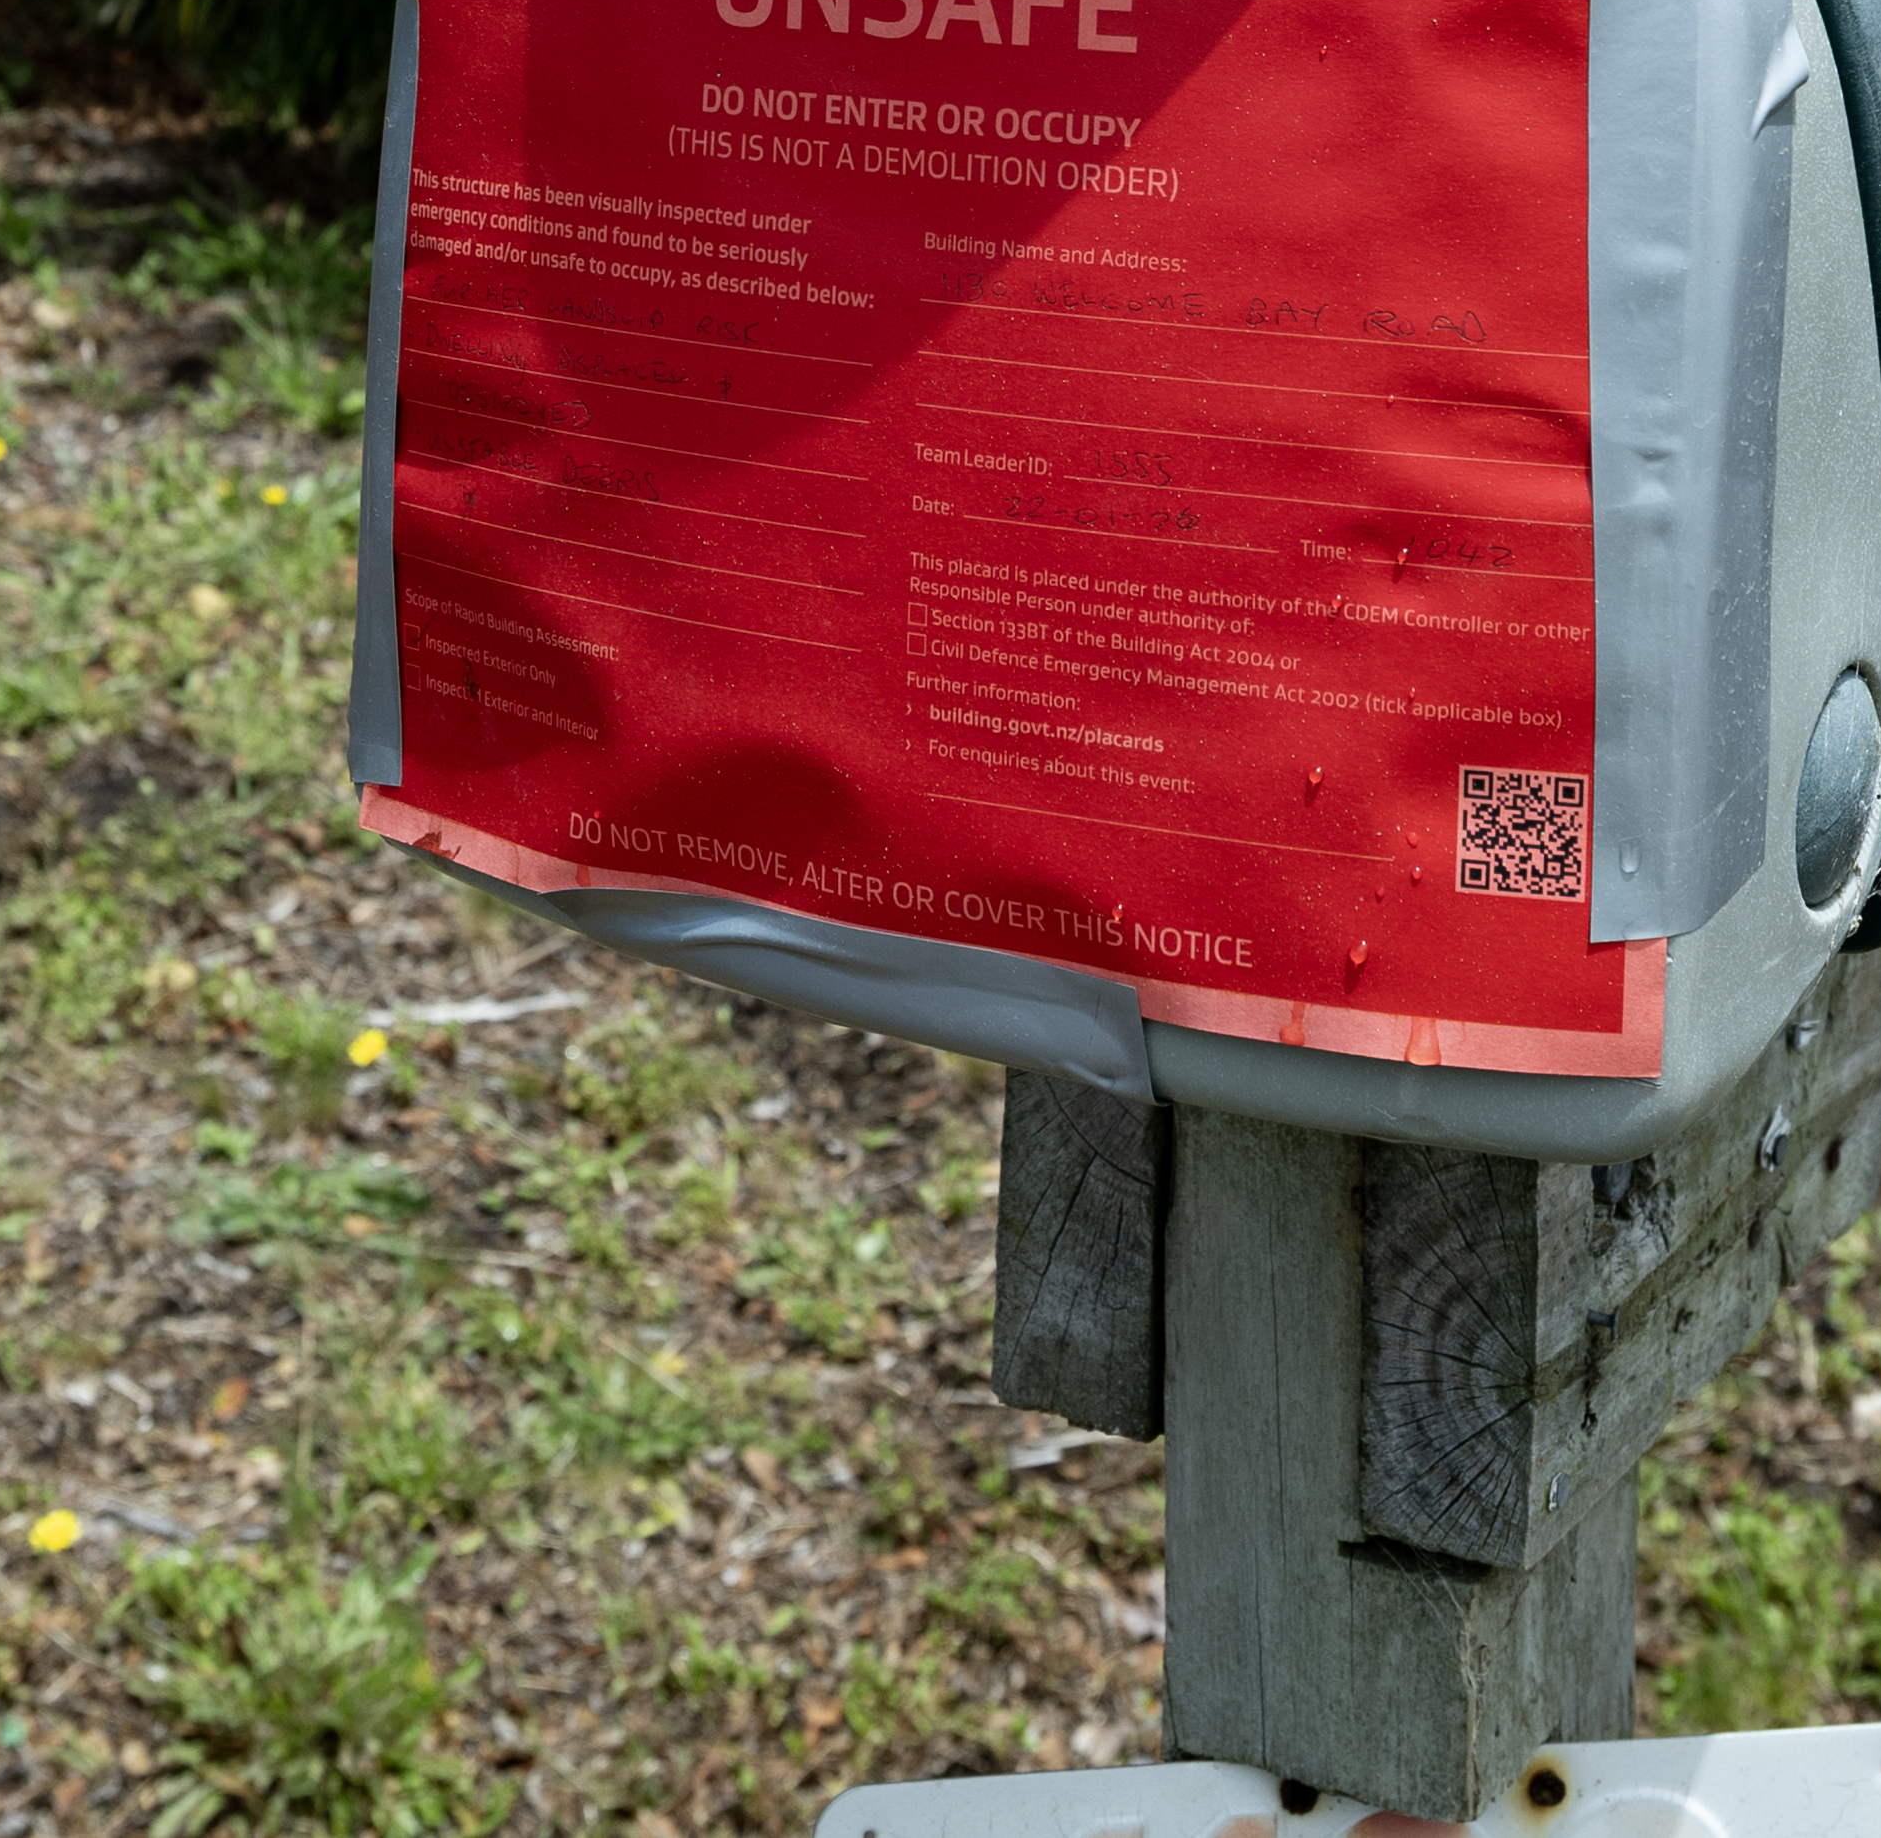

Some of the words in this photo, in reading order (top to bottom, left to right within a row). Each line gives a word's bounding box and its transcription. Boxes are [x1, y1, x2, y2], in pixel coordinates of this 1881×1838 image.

[701, 82, 745, 116] DO
[752, 87, 818, 122] NOT
[824, 93, 928, 133] ENTER
[936, 102, 985, 138] OR
[994, 107, 1142, 149] OCCUPY
[668, 123, 733, 159] (THIS
[740, 132, 765, 162] IS
[772, 135, 831, 169] NOT
[835, 141, 856, 172] A
[863, 144, 1046, 189] DEMOLITION
[1056, 161, 1180, 203] ORDER)
[412, 166, 440, 190] This
[441, 175, 511, 199] structure
[513, 180, 542, 203] has
[544, 184, 585, 209] been
[587, 190, 654, 220] visually
[657, 198, 747, 228] inspected
[751, 211, 813, 236] under
[409, 202, 487, 231] emergency
[490, 211, 573, 239] conditions
[576, 222, 608, 244] and
[611, 224, 664, 251] found
[667, 232, 688, 254] to
[691, 234, 715, 257] be
[718, 241, 809, 272] seriously
[922, 230, 996, 260] Building
[1001, 239, 1055, 263] Name
[1059, 247, 1096, 267] and
[1100, 248, 1188, 274] Address:
[409, 229, 472, 258] damaged
[474, 237, 528, 265] and/or
[529, 246, 586, 274] unsafe
[588, 255, 607, 275] to
[609, 260, 677, 289] occupy,
[680, 269, 703, 288] as
[705, 270, 801, 301] described
[806, 284, 875, 310] below:
[1033, 279, 1206, 318] WELCOME
[1245, 297, 1330, 329] BAY
[563, 455, 659, 502] DEBRIS
[910, 493, 956, 517] Date:
[1299, 538, 1352, 561] Time:
[404, 587, 439, 614] Scope
[440, 599, 453, 615] of
[454, 601, 485, 626] Rapid
[486, 610, 535, 644] Building
[535, 626, 620, 663] Assessment:
[909, 576, 1012, 606] Responsible
[1015, 590, 1077, 613] Person
[1080, 598, 1135, 622] under
[1138, 609, 1226, 635] authority
[1229, 618, 1255, 636] of:
[910, 550, 944, 572] This
[947, 557, 1010, 581] placard
[1014, 566, 1029, 583] is
[1032, 568, 1090, 591] placed
[1094, 576, 1148, 598] under
[1151, 582, 1184, 602] the
[1187, 587, 1276, 613] authority
[1280, 597, 1302, 614] of
[1305, 599, 1338, 619] the
[1343, 602, 1399, 625] CDEM
[1403, 609, 1501, 636] Controller
[1507, 620, 1529, 637] or
[1534, 622, 1592, 642] other
[424, 633, 481, 663] Inspected
[482, 649, 527, 678] Exterior
[528, 666, 557, 690] Only
[931, 608, 995, 634] Section
[998, 620, 1050, 641] 133BT
[1052, 626, 1073, 644] of
[1075, 628, 1106, 648] the
[1110, 632, 1185, 662] Building
[1189, 642, 1222, 663] Act
[1226, 648, 1275, 671] 2004
[1279, 654, 1301, 671] or
[905, 670, 969, 695] Further
[972, 682, 1082, 712] information:
[930, 639, 965, 660] Civil
[969, 644, 1039, 670] Defence
[1043, 654, 1142, 686] Emergency
[1146, 667, 1270, 699] Management
[1273, 683, 1306, 703] Act
[1310, 690, 1361, 710] 2002
[1365, 692, 1408, 716] (tick
[1411, 701, 1514, 725] applicable
[1518, 707, 1563, 730] box)
[483, 690, 531, 720] Exterior
[531, 706, 554, 728] and
[555, 712, 600, 742] Interior
[928, 703, 1165, 753] building.govt.nz/placards
[927, 738, 956, 759] For
[959, 745, 1040, 771] enquiries
[1043, 755, 1097, 780] about
[1100, 765, 1135, 786] this
[1138, 772, 1196, 794] event:
[569, 812, 604, 846] DO
[609, 823, 668, 855] NOT
[677, 833, 796, 888] REMOVE,
[800, 861, 885, 906] ALTER
[892, 880, 936, 912] OR
[943, 889, 1047, 934] COVER
[1052, 907, 1124, 948] THIS
[1133, 922, 1254, 970] NOTICE
